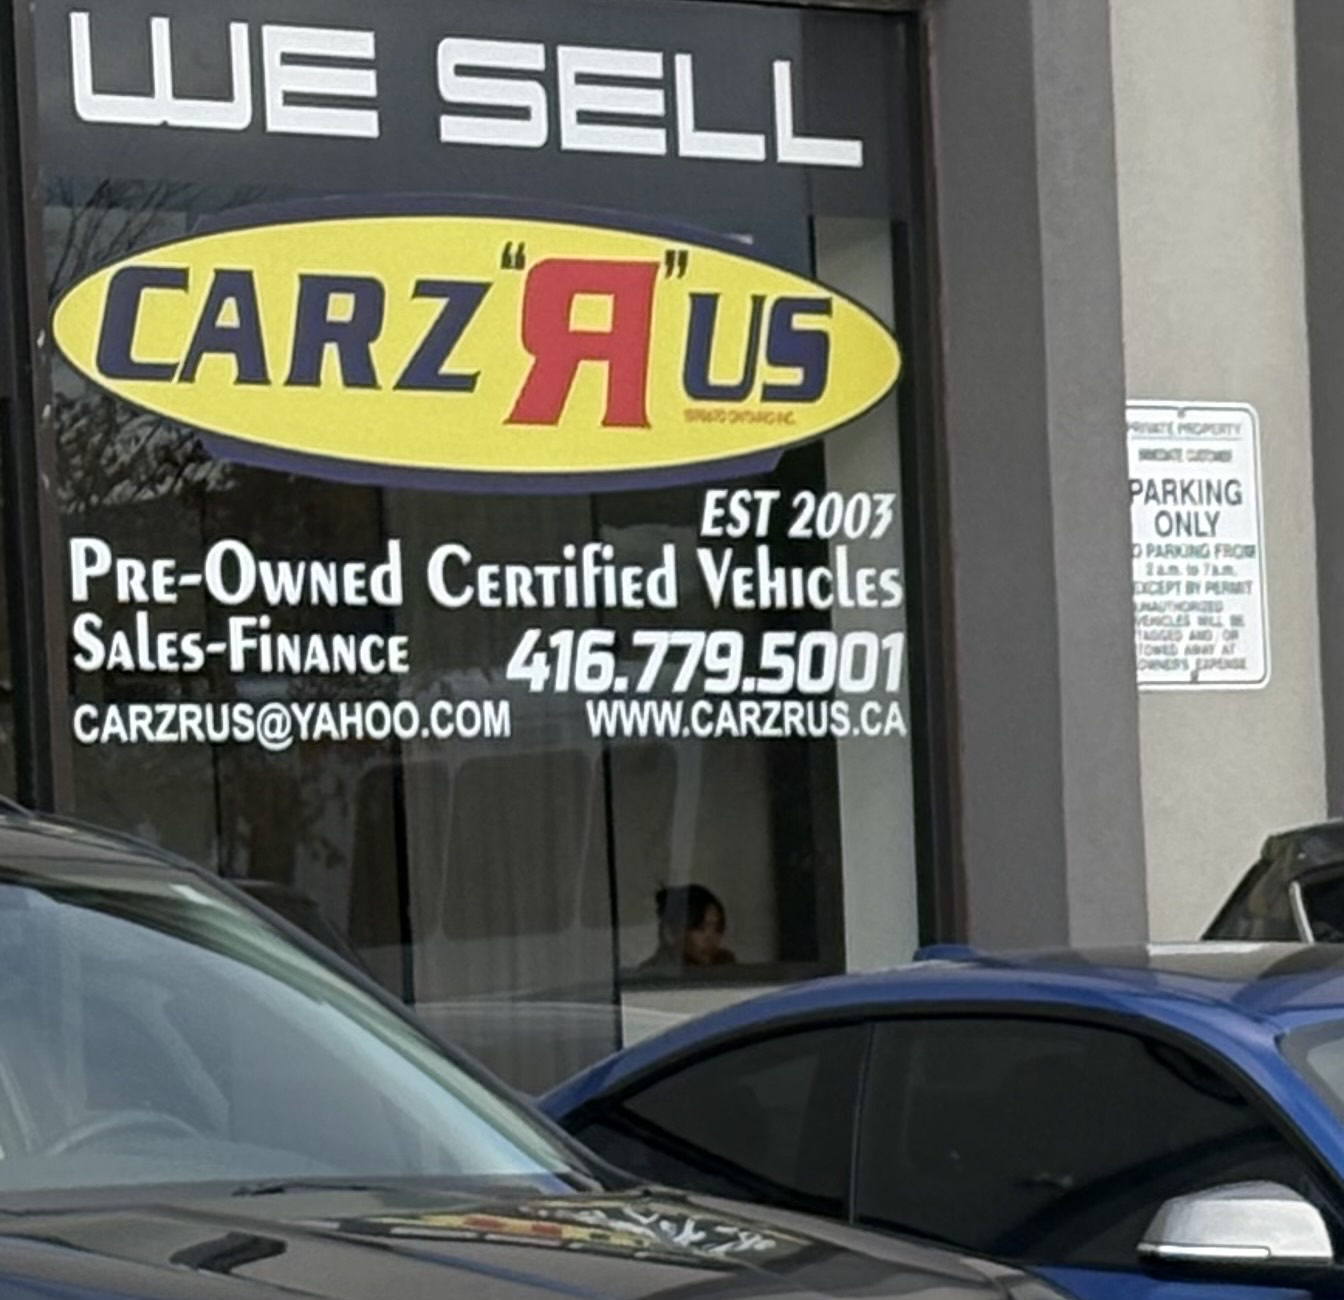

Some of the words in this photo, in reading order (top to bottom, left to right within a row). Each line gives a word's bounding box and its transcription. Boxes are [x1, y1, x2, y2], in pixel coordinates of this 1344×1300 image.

[70, 11, 380, 139] WE
[436, 37, 864, 167] SELL
[96, 265, 493, 394] CARZ
[681, 291, 834, 405] US
[701, 489, 780, 538] EST
[788, 490, 897, 539] 2003
[1129, 478, 1243, 506] PARKING
[1155, 510, 1220, 537] ONLY
[1146, 543, 1210, 559] PARKING
[505, 627, 906, 694] 416.779.5001
[73, 699, 511, 751] CARZRUS@YAHOO.COM
[586, 699, 908, 737] WWW.CARZRUS.CA
